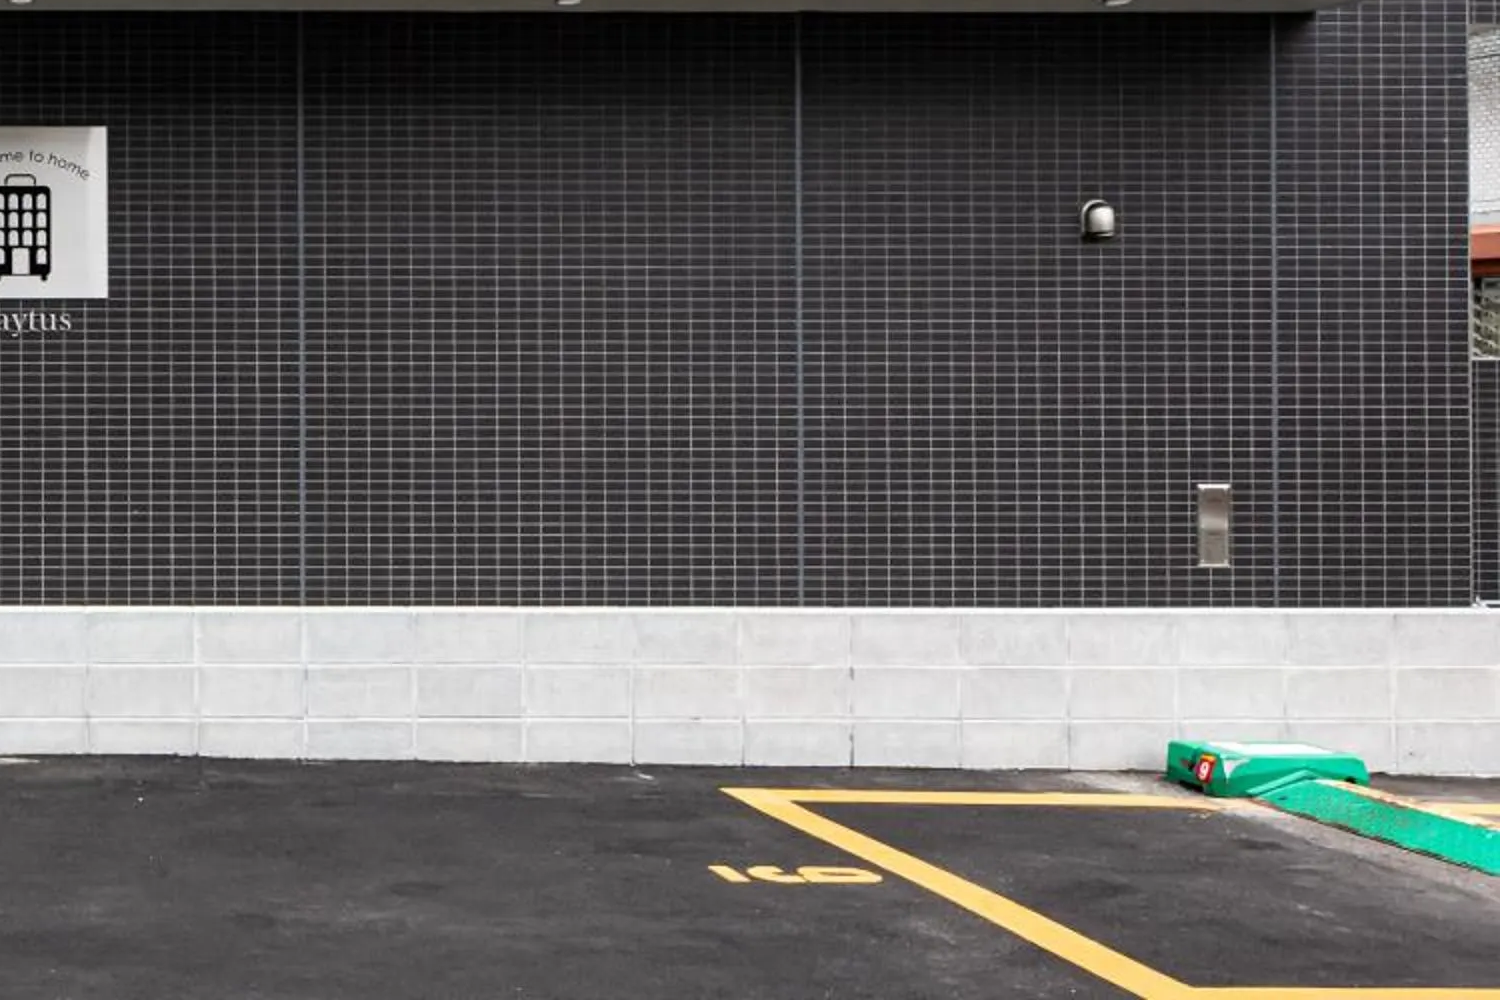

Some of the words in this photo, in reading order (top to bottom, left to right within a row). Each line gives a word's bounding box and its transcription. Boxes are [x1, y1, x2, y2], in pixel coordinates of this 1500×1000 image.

[29, 150, 45, 163] to
[48, 152, 90, 181] home
[1200, 761, 1209, 780] 9
